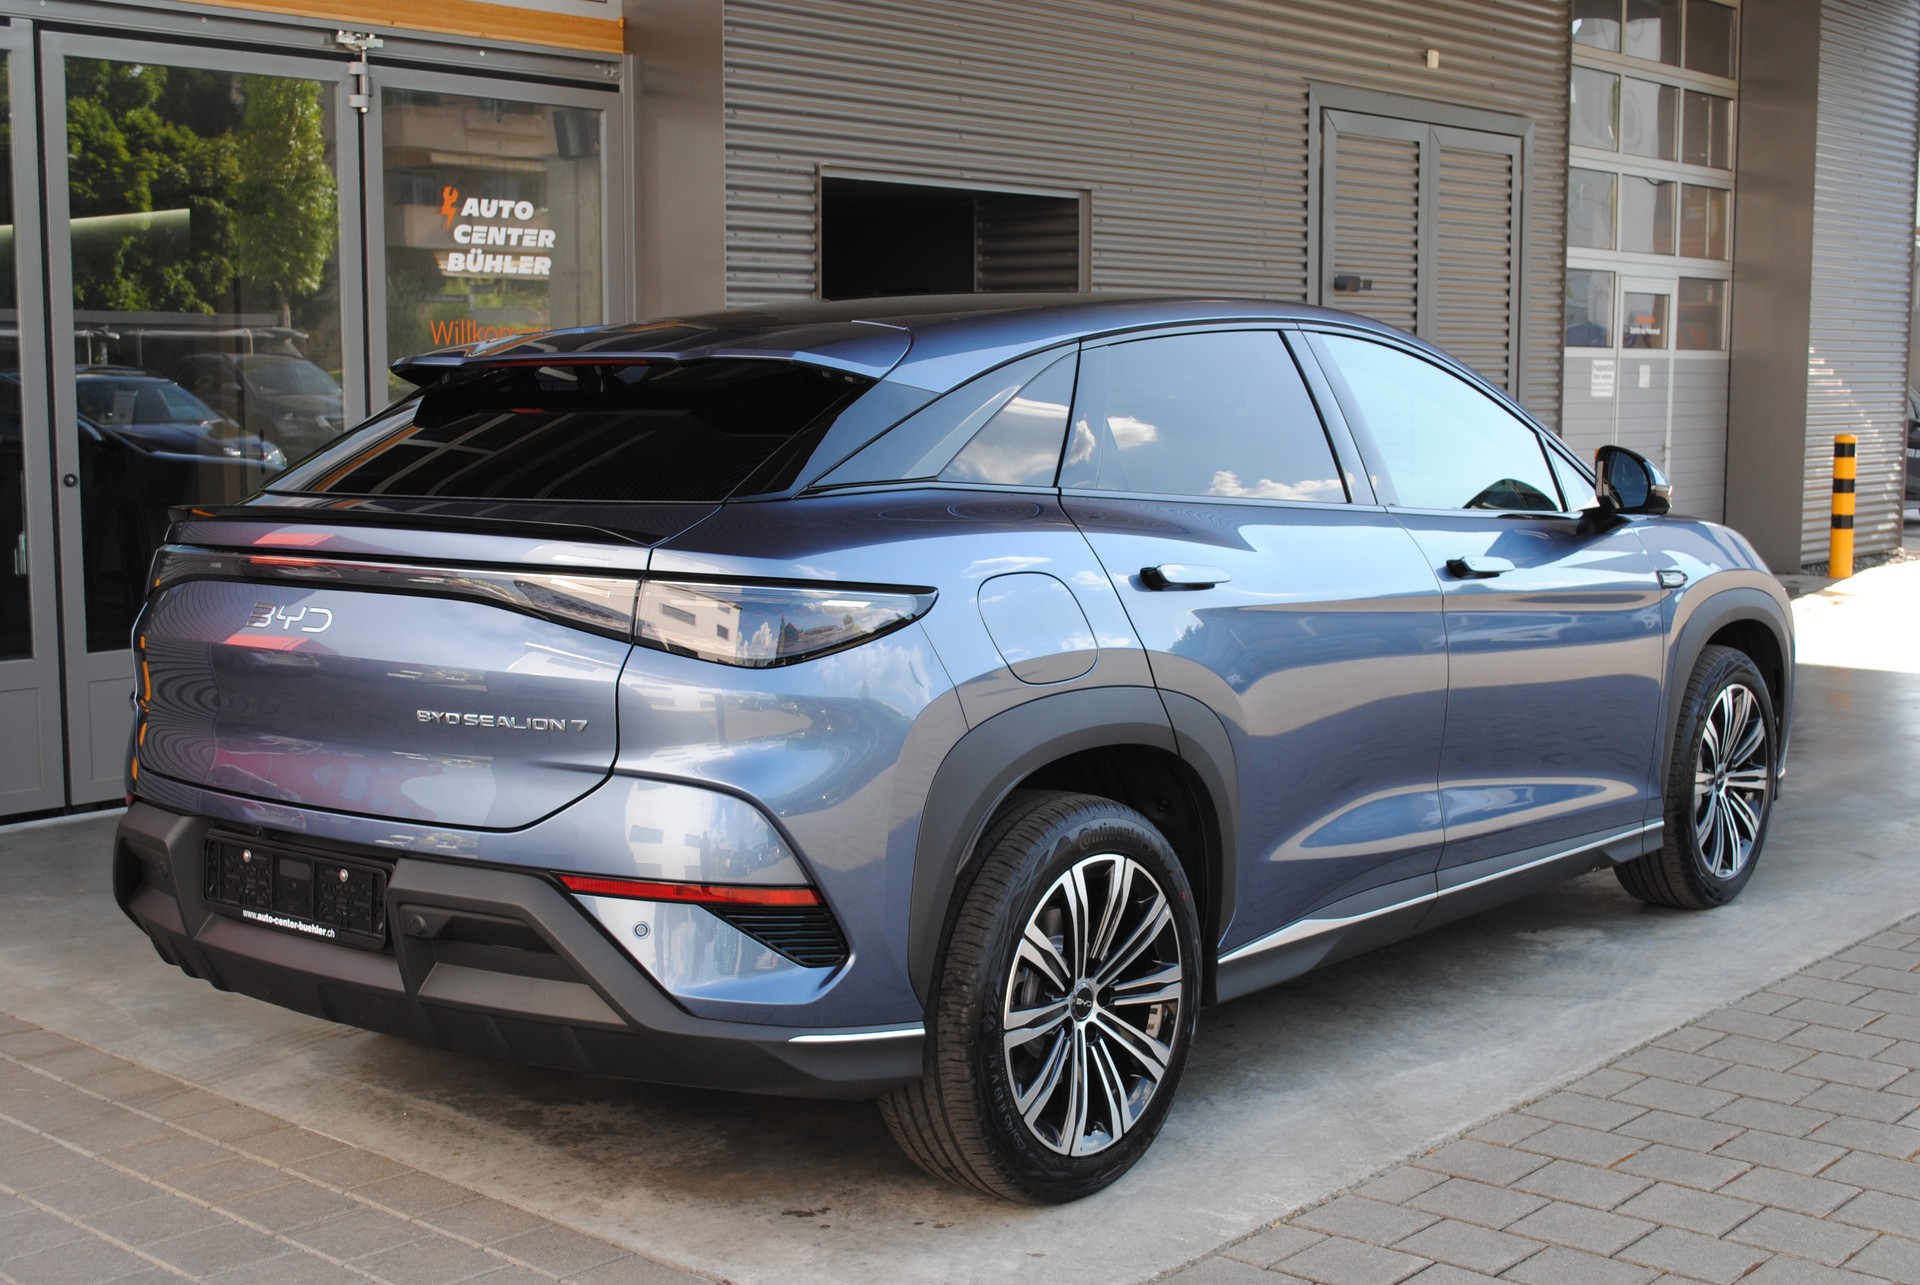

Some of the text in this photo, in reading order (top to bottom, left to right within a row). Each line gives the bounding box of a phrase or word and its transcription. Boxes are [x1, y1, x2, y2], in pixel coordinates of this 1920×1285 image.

[461, 198, 535, 221] AUTO
[453, 224, 556, 248] CENTER
[447, 248, 552, 275] BÜHLER
[246, 602, 333, 633] BYD
[416, 709, 588, 732] BYD SEALION 7
[242, 909, 335, 938] www.auto-center-buehler.ch
